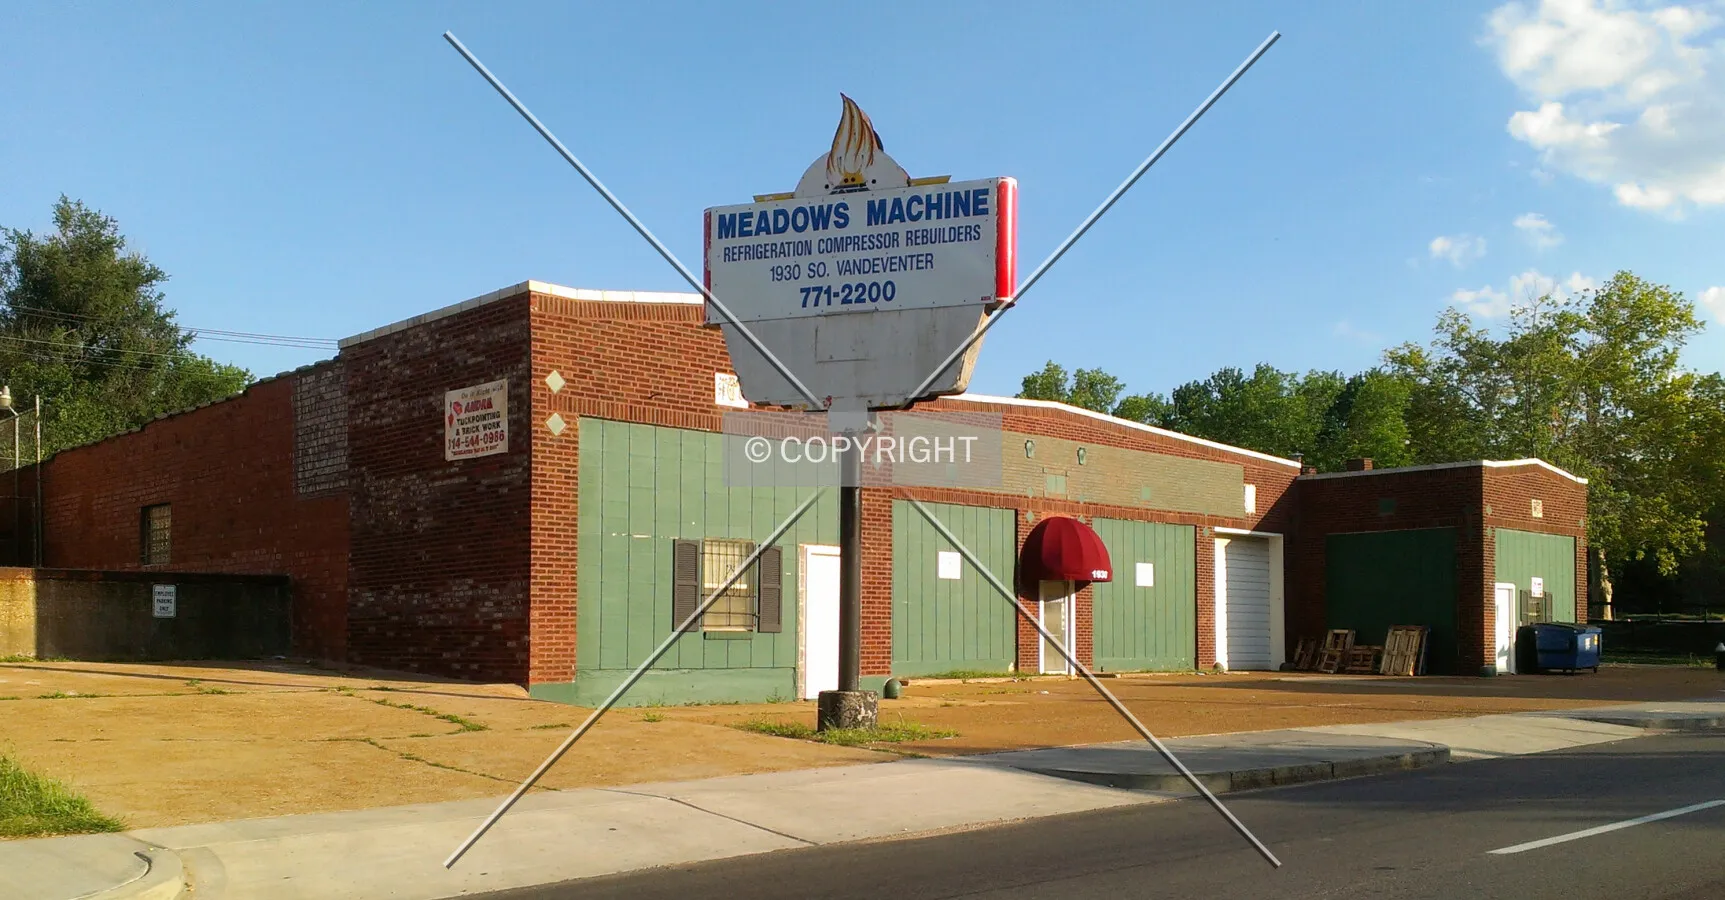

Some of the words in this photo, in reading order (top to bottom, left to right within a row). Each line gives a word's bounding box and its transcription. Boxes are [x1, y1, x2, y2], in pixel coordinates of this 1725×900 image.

[718, 202, 850, 239] MEADOWS
[867, 188, 990, 227] MACHINE
[723, 240, 812, 263] REFRIGERATION
[817, 230, 900, 255] COMPRESSOR
[905, 224, 982, 247] REBUILDERS
[770, 264, 801, 282] 1930
[807, 261, 830, 279] SO.
[836, 252, 934, 277] VANDEVENTER
[800, 280, 896, 308] 771-2200
[457, 411, 500, 425] TUCKPOINTING
[462, 425, 480, 435] BRICK
[482, 421, 501, 431] WORK
